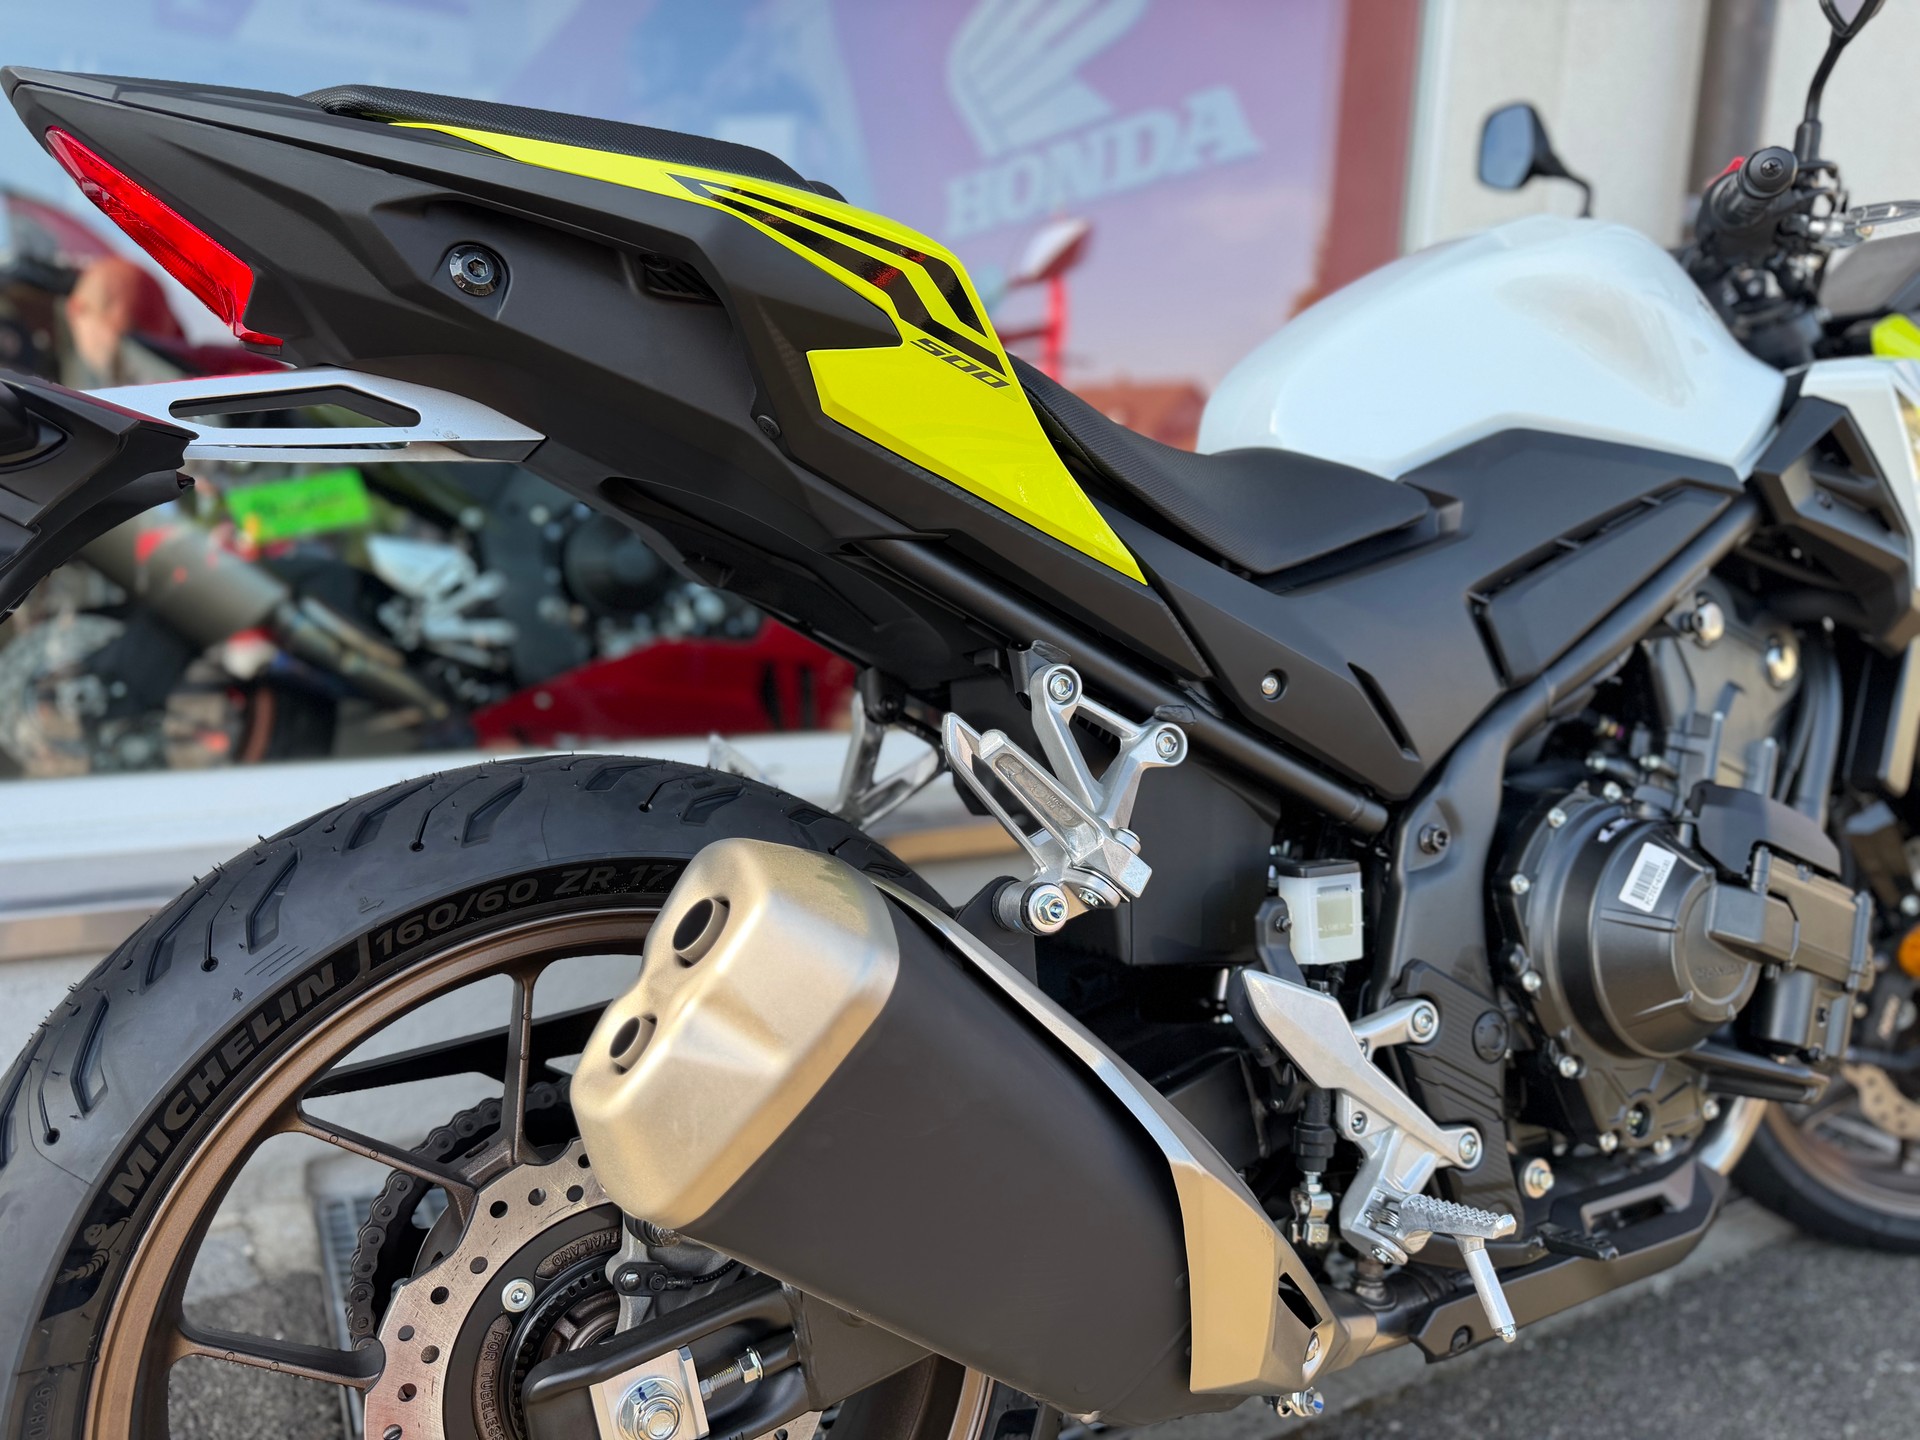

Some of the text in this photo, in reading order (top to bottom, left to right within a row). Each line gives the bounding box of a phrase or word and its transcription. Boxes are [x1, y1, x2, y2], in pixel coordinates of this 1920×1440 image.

[946, 86, 1262, 241] HONDA
[909, 338, 1011, 389] 500
[375, 864, 679, 956] 160/60 ZR 17
[107, 962, 336, 1208] MICHELIN
[551, 1231, 620, 1267] THAILAND
[484, 1330, 504, 1361] FOR
